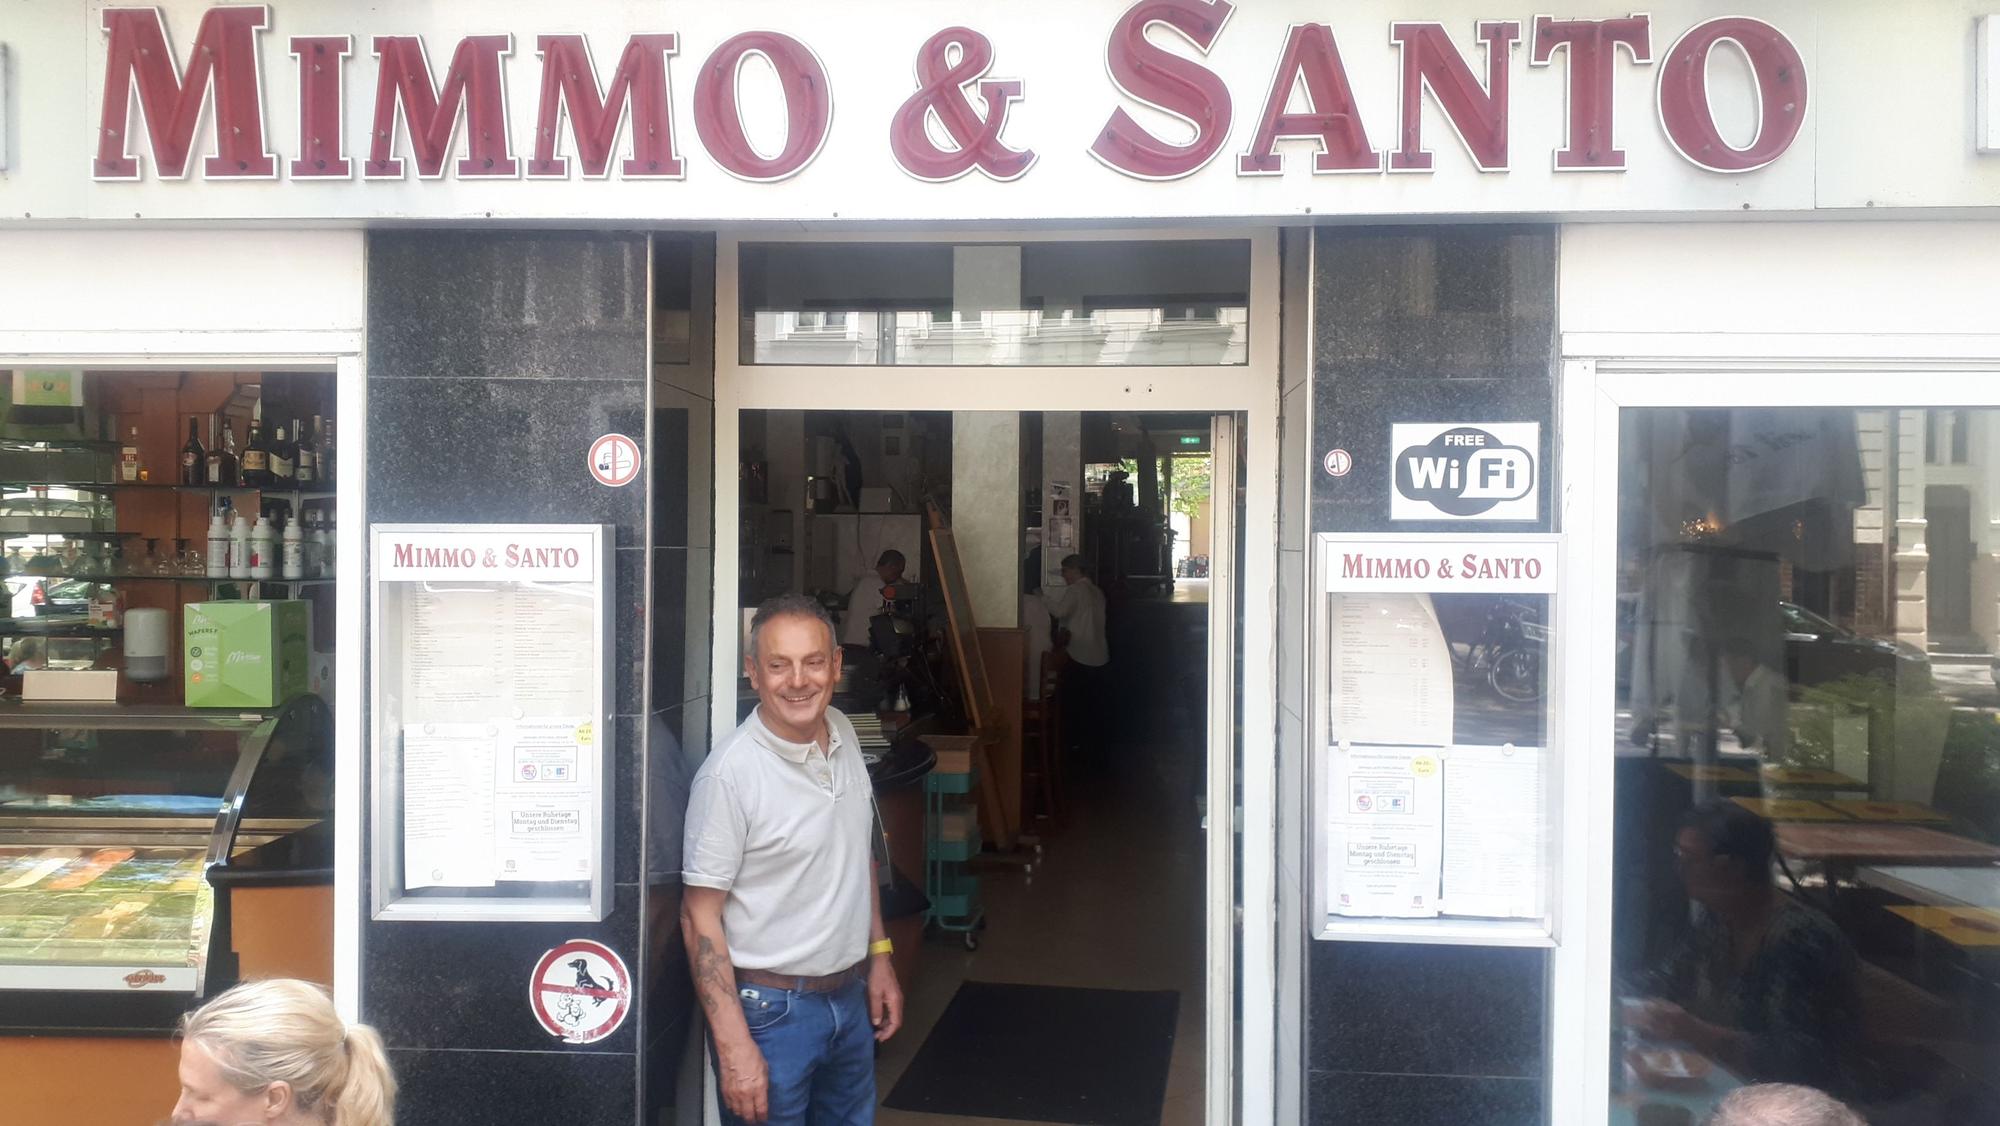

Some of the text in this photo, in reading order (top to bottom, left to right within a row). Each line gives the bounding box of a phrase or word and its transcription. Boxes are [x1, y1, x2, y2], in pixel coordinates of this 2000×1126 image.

[889, 26, 1040, 183] &
[1444, 434, 1485, 447] FREE
[482, 547, 498, 568] &
[1437, 558, 1454, 579] &
[520, 810, 571, 819] Unsere Ruhetage
[527, 825, 565, 833] geschlossen
[1356, 842, 1378, 850] Unsere
[1349, 850, 1414, 860] Montag und Dienstag
